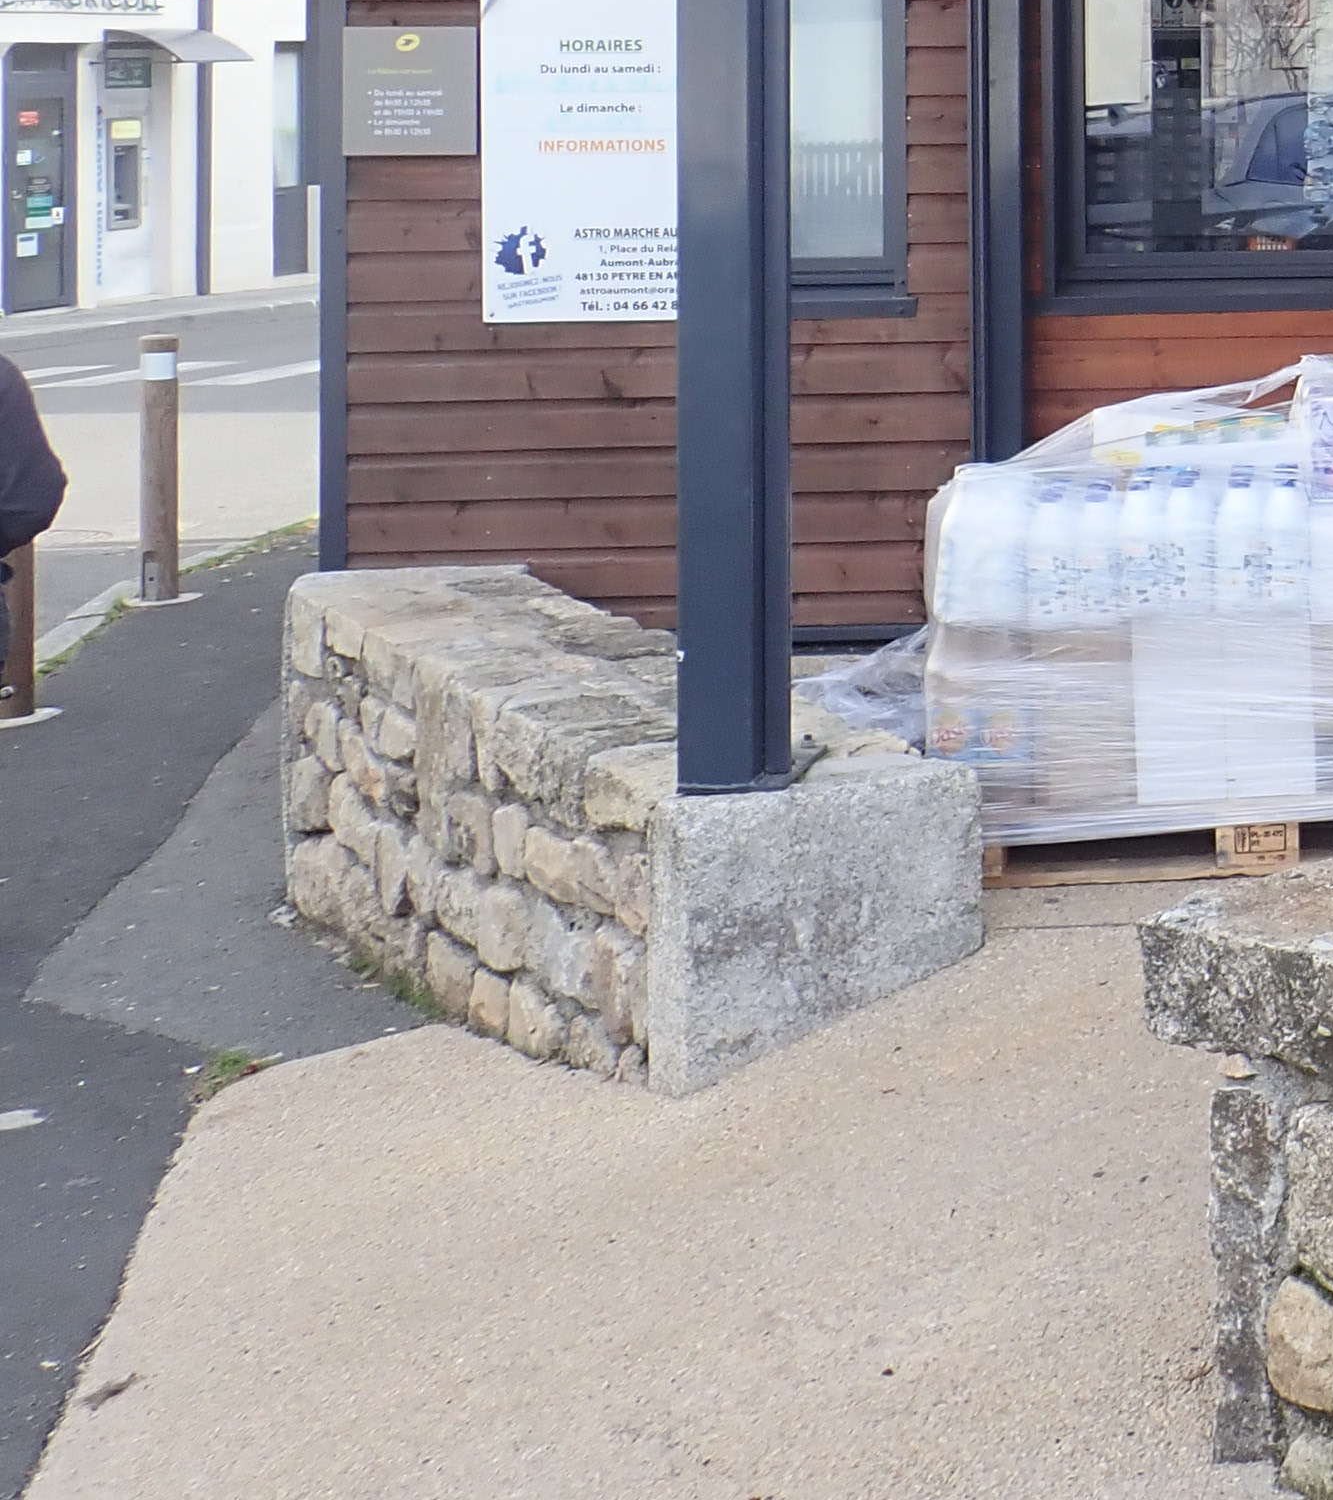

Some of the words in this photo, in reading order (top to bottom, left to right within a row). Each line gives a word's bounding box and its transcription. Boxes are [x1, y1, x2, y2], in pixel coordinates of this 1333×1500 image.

[559, 39, 643, 52] HORAIRES
[540, 64, 557, 74] Du
[560, 64, 591, 74] lundi
[594, 66, 609, 74] au
[612, 64, 655, 74] samedi
[560, 103, 573, 113] Le
[576, 103, 635, 113] dimanche
[538, 139, 667, 152] INFORMATIONS
[574, 228, 611, 239] ASTRO
[613, 228, 660, 238] MARCHE
[610, 245, 637, 254] Place
[640, 245, 654, 254] du
[575, 272, 609, 282] 48130
[611, 272, 646, 281] PEYRE
[648, 272, 664, 280] EN
[581, 301, 603, 312] Tél.
[613, 301, 630, 311] 04
[632, 301, 649, 311] 66
[651, 301, 667, 311] 42
